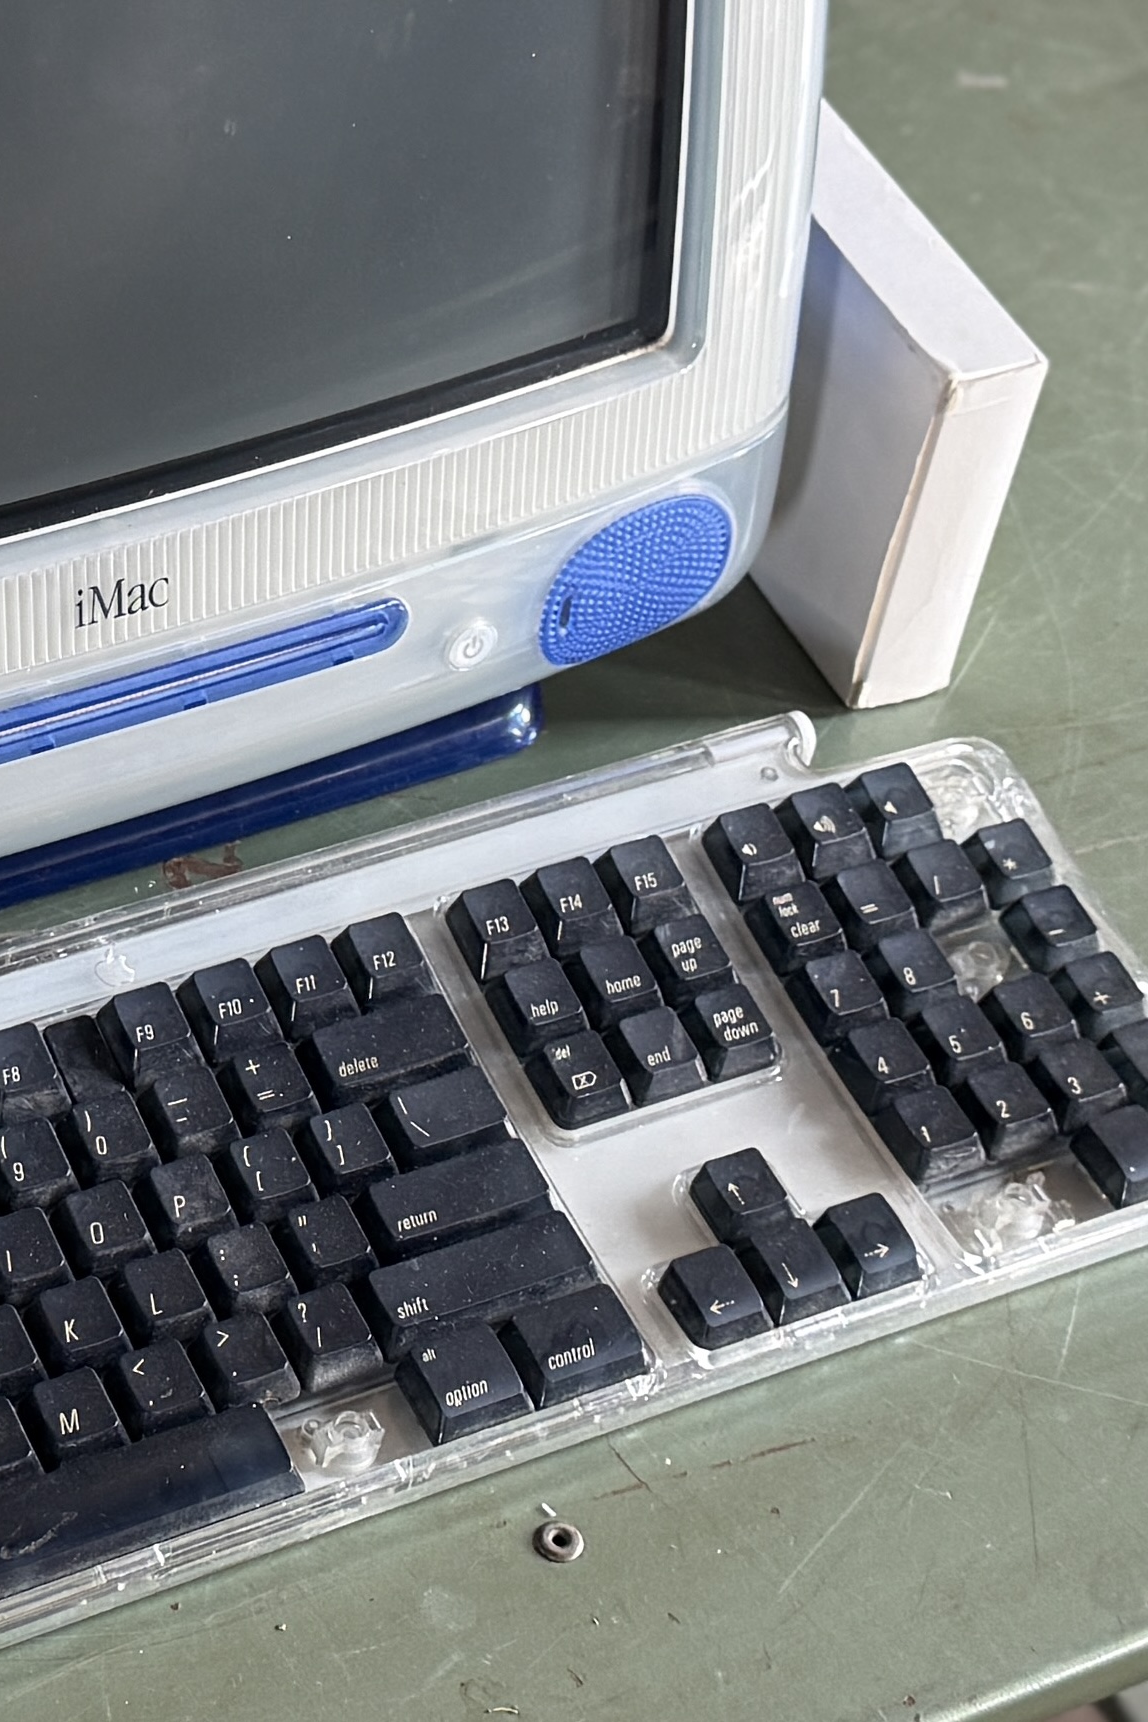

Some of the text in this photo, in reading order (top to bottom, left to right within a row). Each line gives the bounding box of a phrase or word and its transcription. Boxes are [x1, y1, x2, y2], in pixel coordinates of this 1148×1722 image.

[75, 577, 169, 629] iMac
[634, 872, 658, 891] F15
[559, 893, 583, 913] F14
[777, 903, 799, 919] lock
[485, 915, 510, 936] F13
[790, 919, 820, 938] clear
[671, 937, 702, 959] page
[372, 950, 397, 971] F12
[681, 957, 698, 973] up
[295, 974, 316, 994] F11
[605, 975, 642, 995] home
[903, 966, 917, 986] 8
[829, 988, 840, 1008] 7
[218, 998, 242, 1020] F10
[530, 998, 559, 1020] help
[712, 1006, 744, 1029] page
[1020, 1011, 1035, 1030] 6
[135, 1024, 155, 1043] F9
[722, 1020, 759, 1042] down
[948, 1034, 962, 1054] 5
[647, 1045, 671, 1067] end
[877, 1056, 889, 1074] 4
[2, 1066, 21, 1086] F8
[338, 1056, 379, 1078] delete
[1067, 1076, 1082, 1095] 3
[995, 1099, 1011, 1119] 2
[920, 1125, 931, 1143] 1
[12, 1161, 25, 1182] 9
[173, 1195, 186, 1218] P
[397, 1210, 438, 1233] return
[149, 1293, 163, 1316] L
[297, 1302, 307, 1323] ?
[397, 1296, 429, 1319] shift
[64, 1318, 79, 1343] K
[216, 1330, 229, 1348] >
[422, 1348, 437, 1363] alt
[548, 1337, 595, 1371] control
[132, 1358, 145, 1376] <
[445, 1379, 488, 1408] option
[59, 1408, 80, 1435] M
